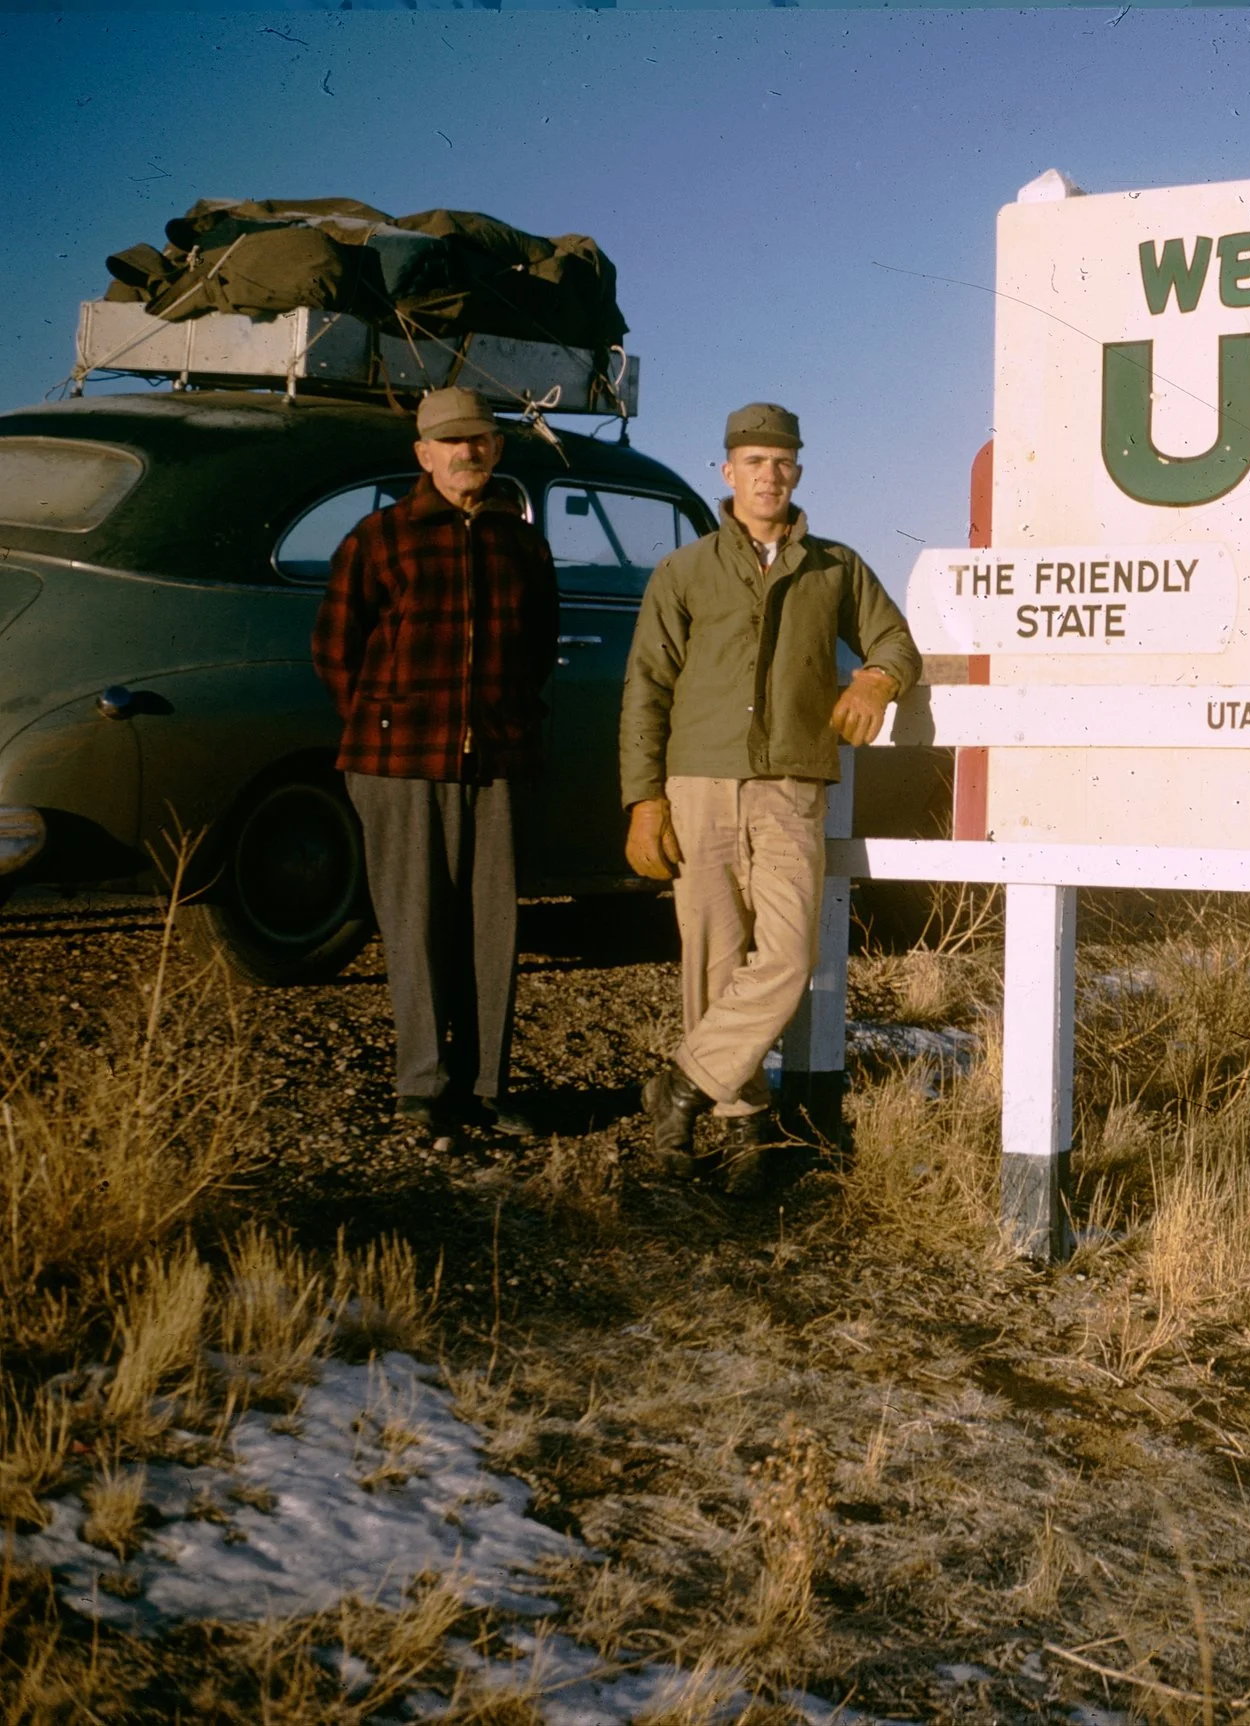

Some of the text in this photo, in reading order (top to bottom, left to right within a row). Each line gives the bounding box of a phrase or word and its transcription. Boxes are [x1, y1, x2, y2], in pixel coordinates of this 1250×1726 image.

[948, 559, 1199, 596] THE FRIENDLY
[1016, 604, 1126, 638] STATE
